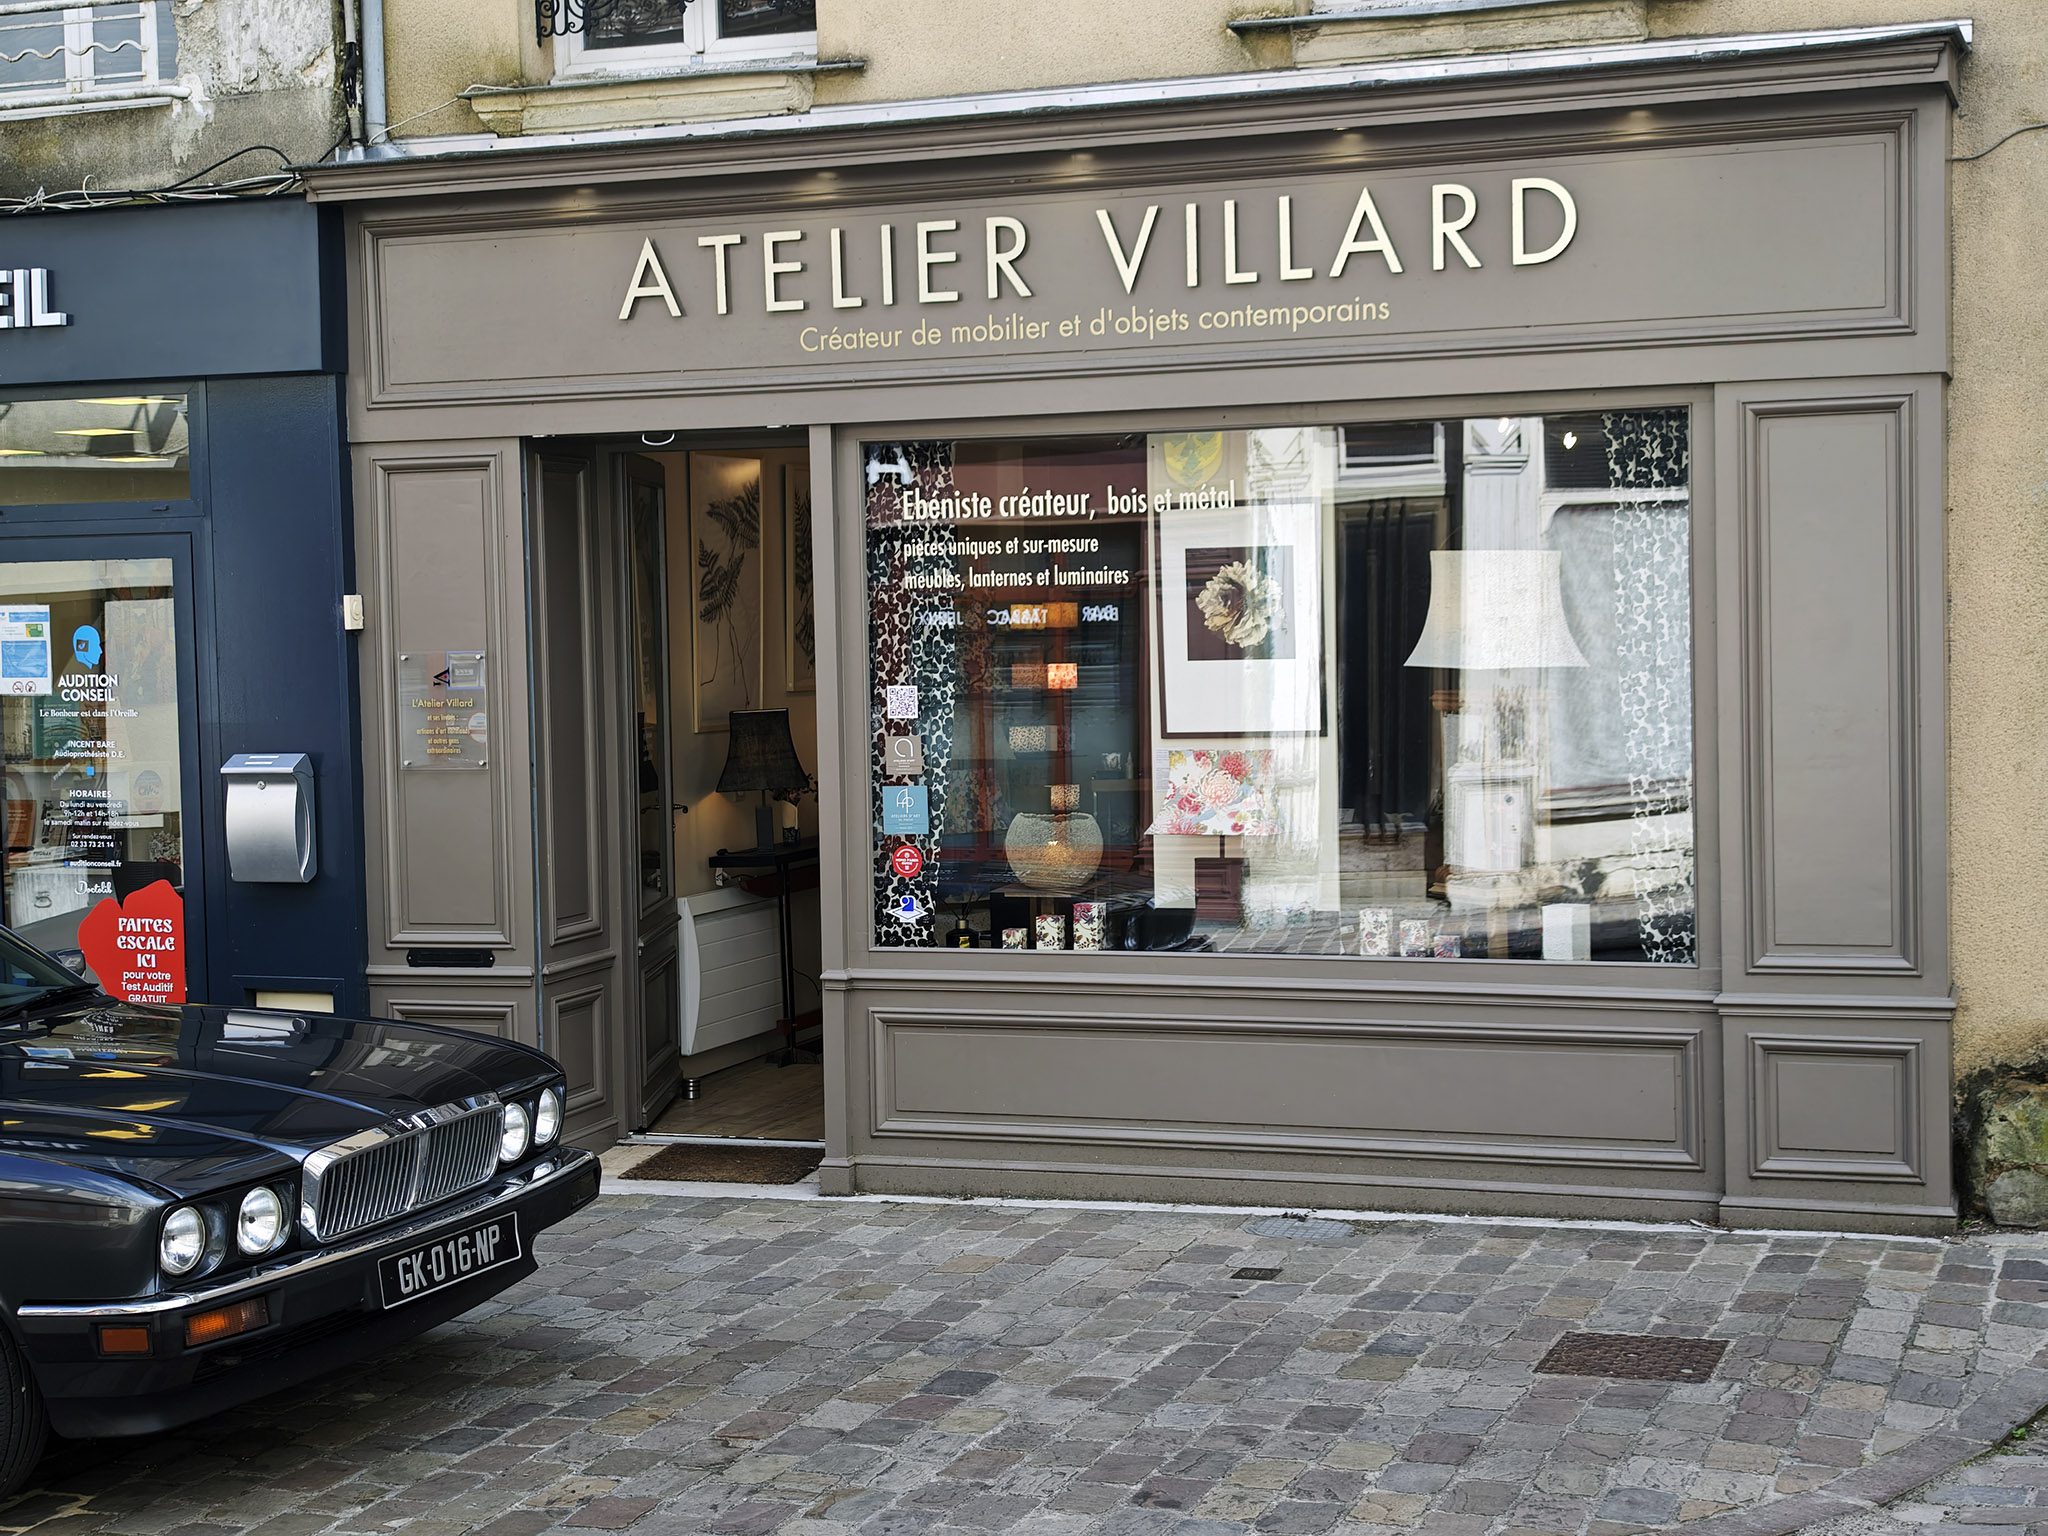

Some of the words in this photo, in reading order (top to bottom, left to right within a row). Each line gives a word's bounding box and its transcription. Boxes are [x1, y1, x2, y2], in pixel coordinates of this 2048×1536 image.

[619, 217, 1032, 320] ATELIER
[1096, 178, 1578, 294] VILLARD
[800, 326, 903, 352] Créateur
[912, 318, 942, 346] de
[952, 313, 1049, 344] mobilier
[1059, 315, 1081, 338] et
[1090, 306, 1189, 339] d'objets
[1199, 296, 1390, 332] contemporains
[903, 489, 992, 521] Ebéniste
[1000, 487, 1095, 520] créateur,
[1107, 485, 1147, 514] bois
[1154, 489, 1173, 513] et
[1179, 480, 1235, 511] métal
[904, 539, 944, 560] pièces
[949, 538, 1002, 559] uniques
[1006, 537, 1019, 553] et
[1023, 537, 1099, 553] sur-mesure
[904, 570, 965, 592] meubles,
[969, 568, 1032, 588] lanternes
[1037, 568, 1050, 586] et
[1054, 564, 1129, 586] luminaires
[58, 674, 119, 688] AUDITION
[61, 688, 116, 702] CONSEIL
[412, 698, 444, 708] L'Atelier
[446, 698, 473, 708] Villard
[40, 709, 50, 718] Le
[51, 709, 79, 718] Bonheur
[80, 709, 91, 718] est
[92, 709, 109, 718] dans
[69, 789, 112, 798] HORAIRES
[60, 800, 69, 808] Du
[70, 800, 85, 808] lundi
[95, 800, 122, 808] vendredi
[118, 917, 173, 933] FAITES
[116, 936, 175, 951] ESCALE
[136, 953, 156, 968] ICI
[123, 971, 145, 980] pour
[146, 971, 171, 980] votre
[121, 981, 141, 992] Test
[142, 982, 173, 992] Auditif
[128, 994, 167, 1004] GRATUIT
